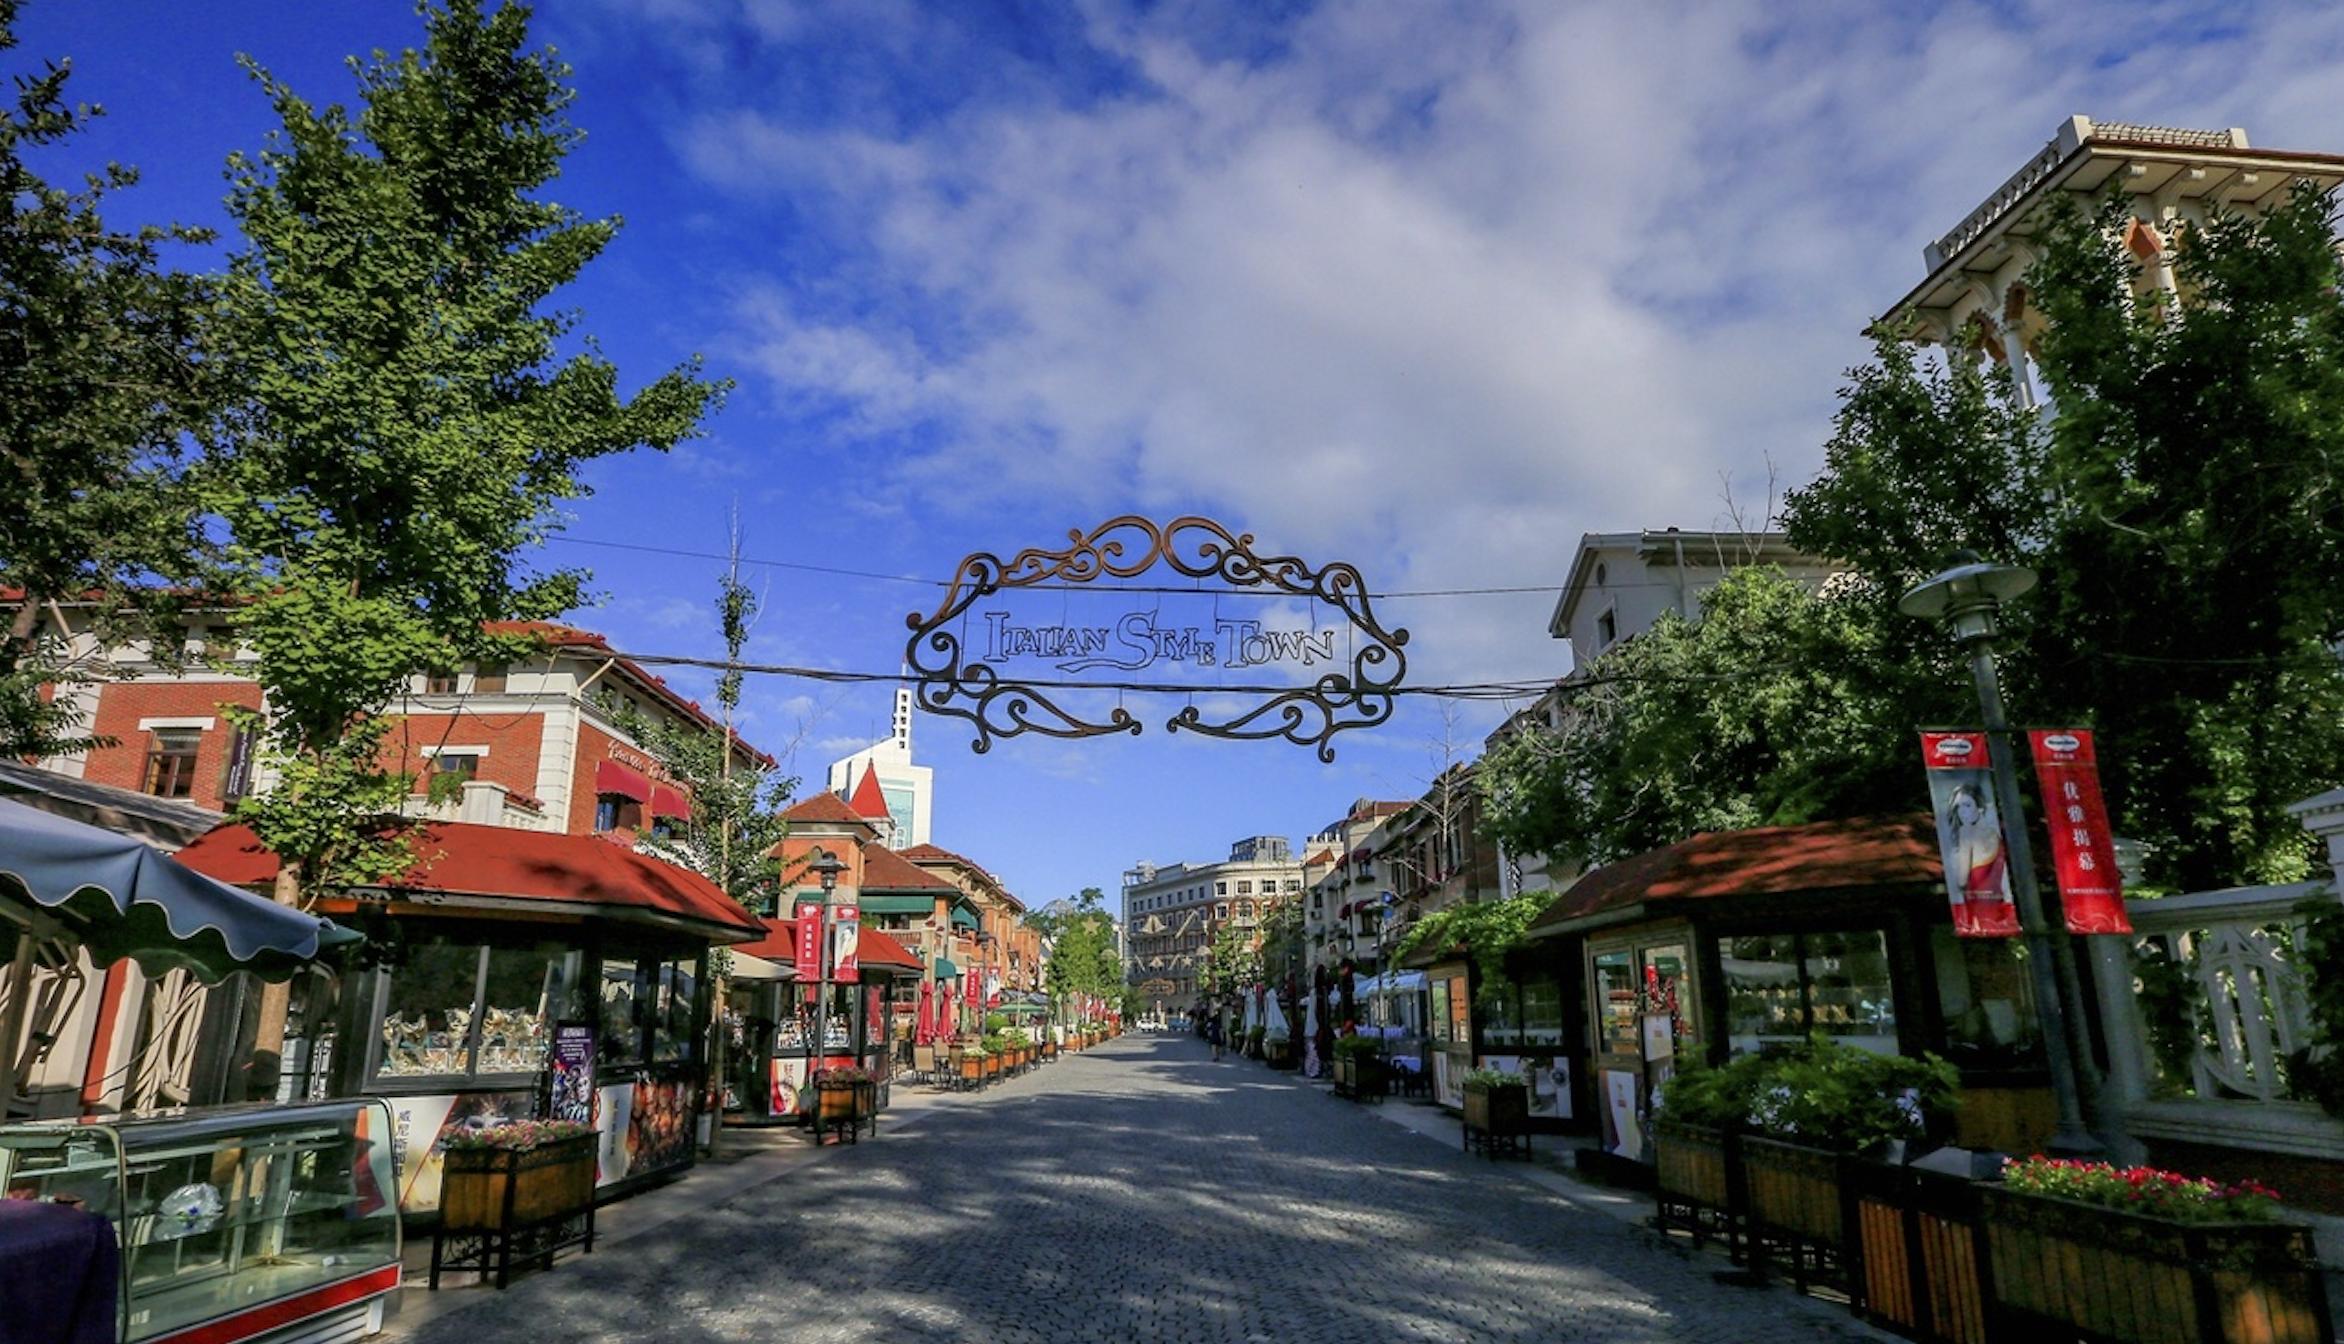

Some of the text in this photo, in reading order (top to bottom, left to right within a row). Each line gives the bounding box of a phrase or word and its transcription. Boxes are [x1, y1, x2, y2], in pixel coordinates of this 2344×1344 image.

[983, 609, 1335, 671] ITALIAN STYLE TOWN
